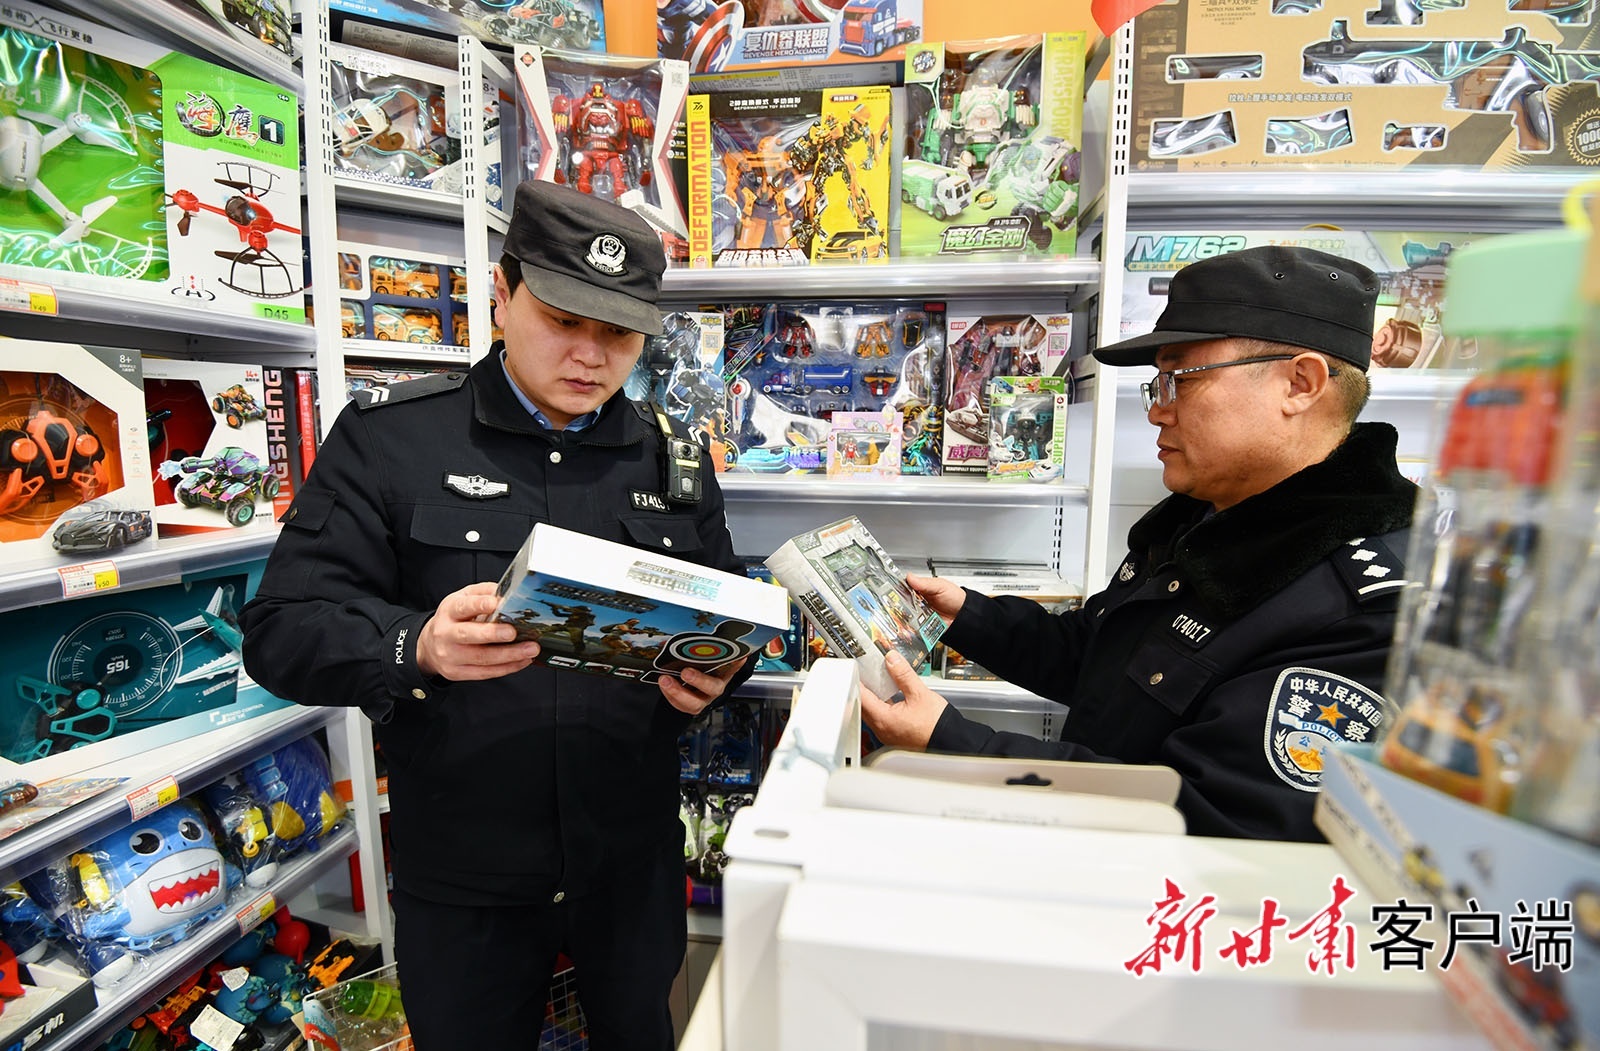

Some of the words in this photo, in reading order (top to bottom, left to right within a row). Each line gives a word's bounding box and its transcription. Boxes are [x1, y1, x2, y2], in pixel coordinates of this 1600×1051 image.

[794, 47, 828, 55] ALLIANCE
[690, 120, 708, 252] DEFORMATION
[264, 308, 290, 321] D45
[119, 354, 133, 364] 8+
[633, 492, 670, 511] FJ415
[1171, 613, 1212, 643] 074017
[395, 628, 409, 665] POLICE
[106, 658, 130, 675] 165
[1289, 676, 1384, 728] 中华人民共和国
[1287, 694, 1314, 719] 警
[1344, 720, 1371, 743] 察
[1301, 721, 1344, 743] POLICE
